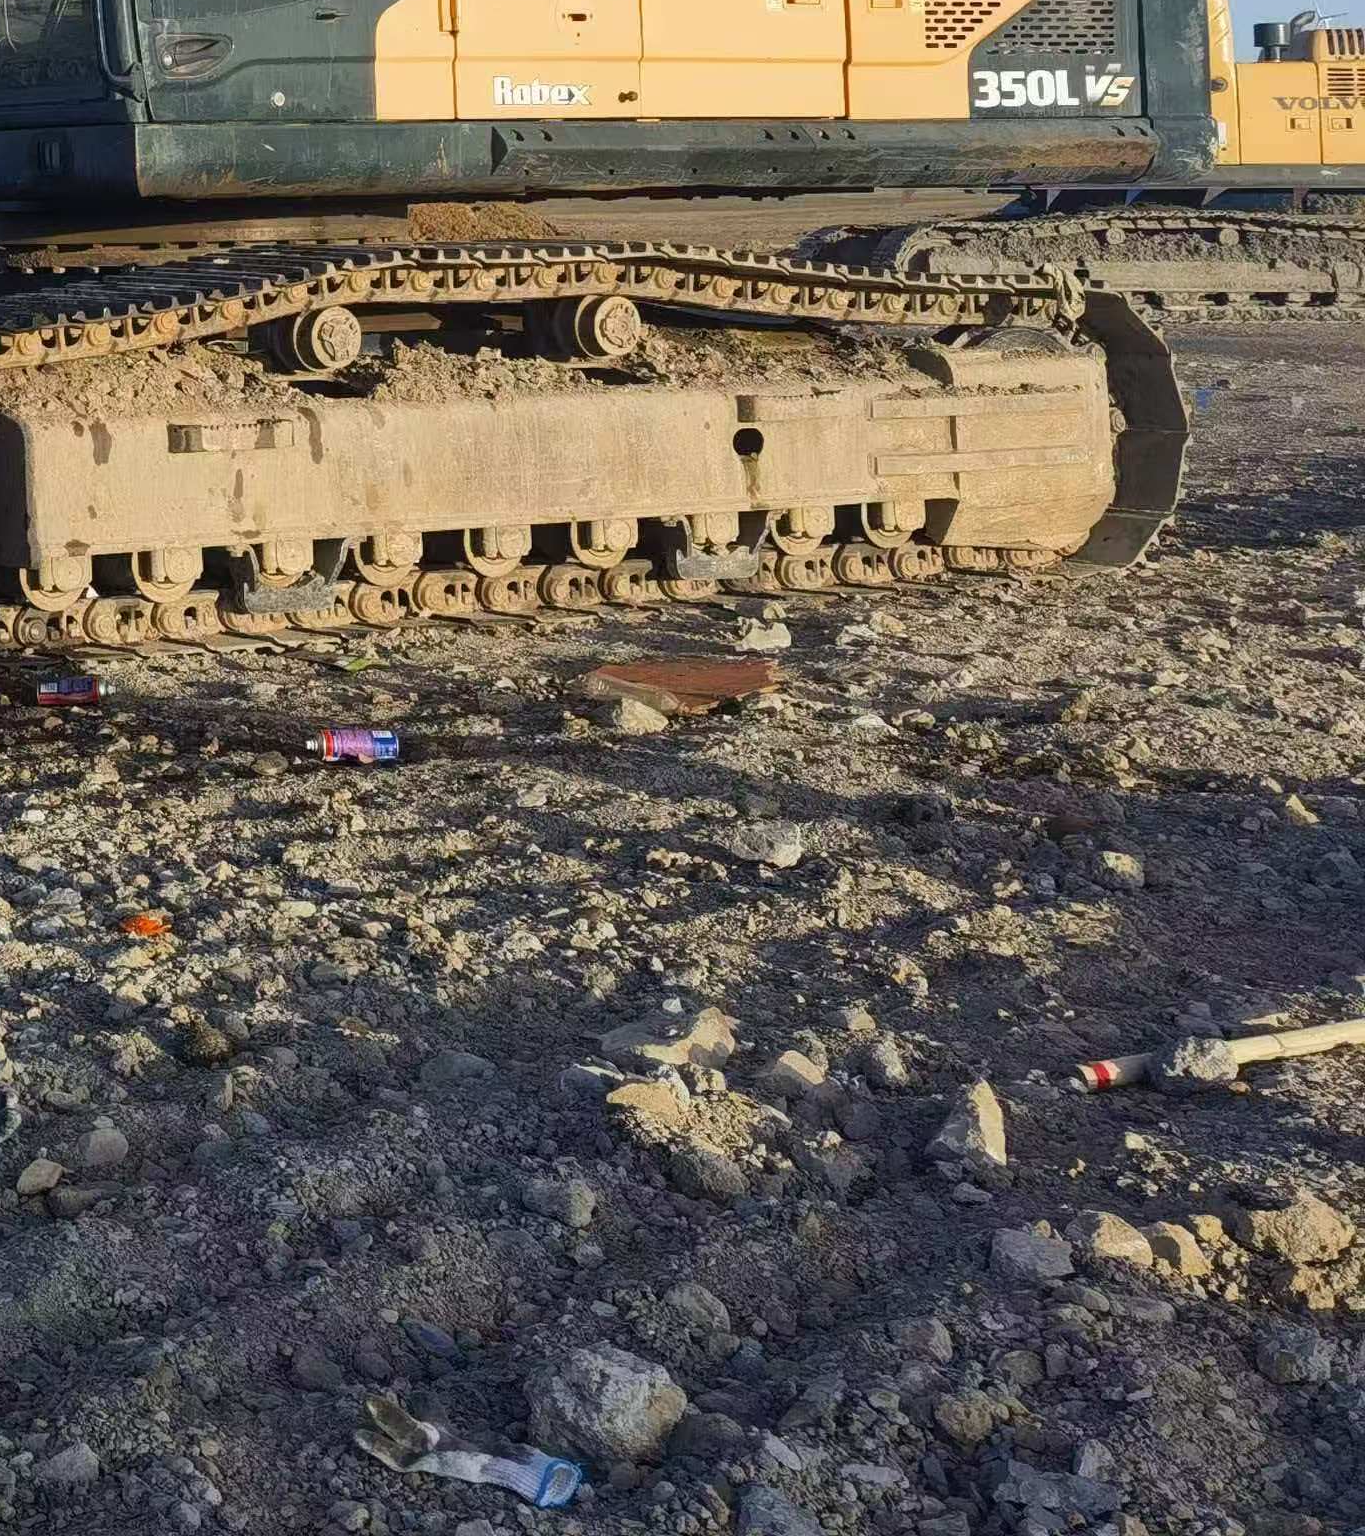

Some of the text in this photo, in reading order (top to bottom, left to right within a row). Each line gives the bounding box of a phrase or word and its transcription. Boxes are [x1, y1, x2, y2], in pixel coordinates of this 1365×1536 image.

[493, 75, 592, 105] Robex
[972, 70, 1079, 107] 350L
[1272, 96, 1365, 110] VOLV
